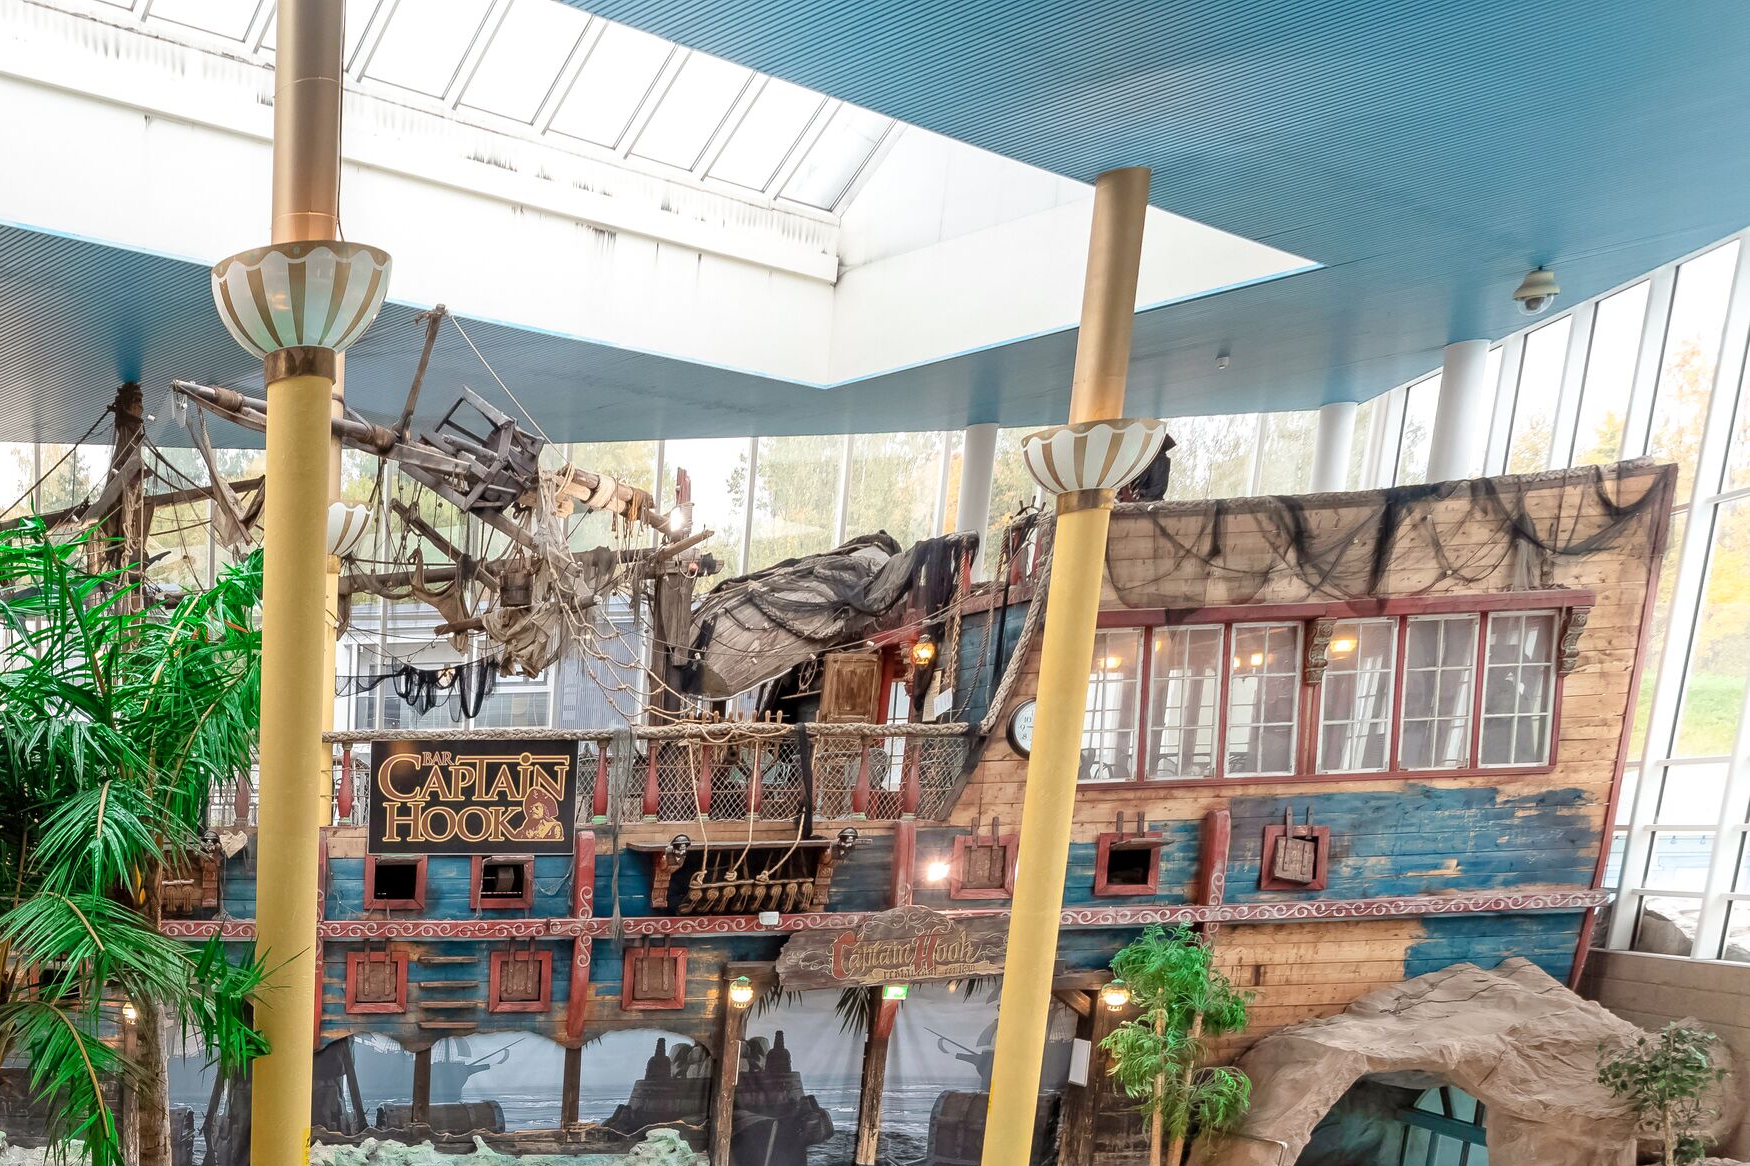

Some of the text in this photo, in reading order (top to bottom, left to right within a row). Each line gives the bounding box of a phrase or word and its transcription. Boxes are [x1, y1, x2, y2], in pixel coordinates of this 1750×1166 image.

[378, 752, 570, 802] CAPTAIN
[422, 751, 454, 766] BAR
[382, 802, 523, 842] HOOK
[830, 926, 977, 980] Captain Hook
